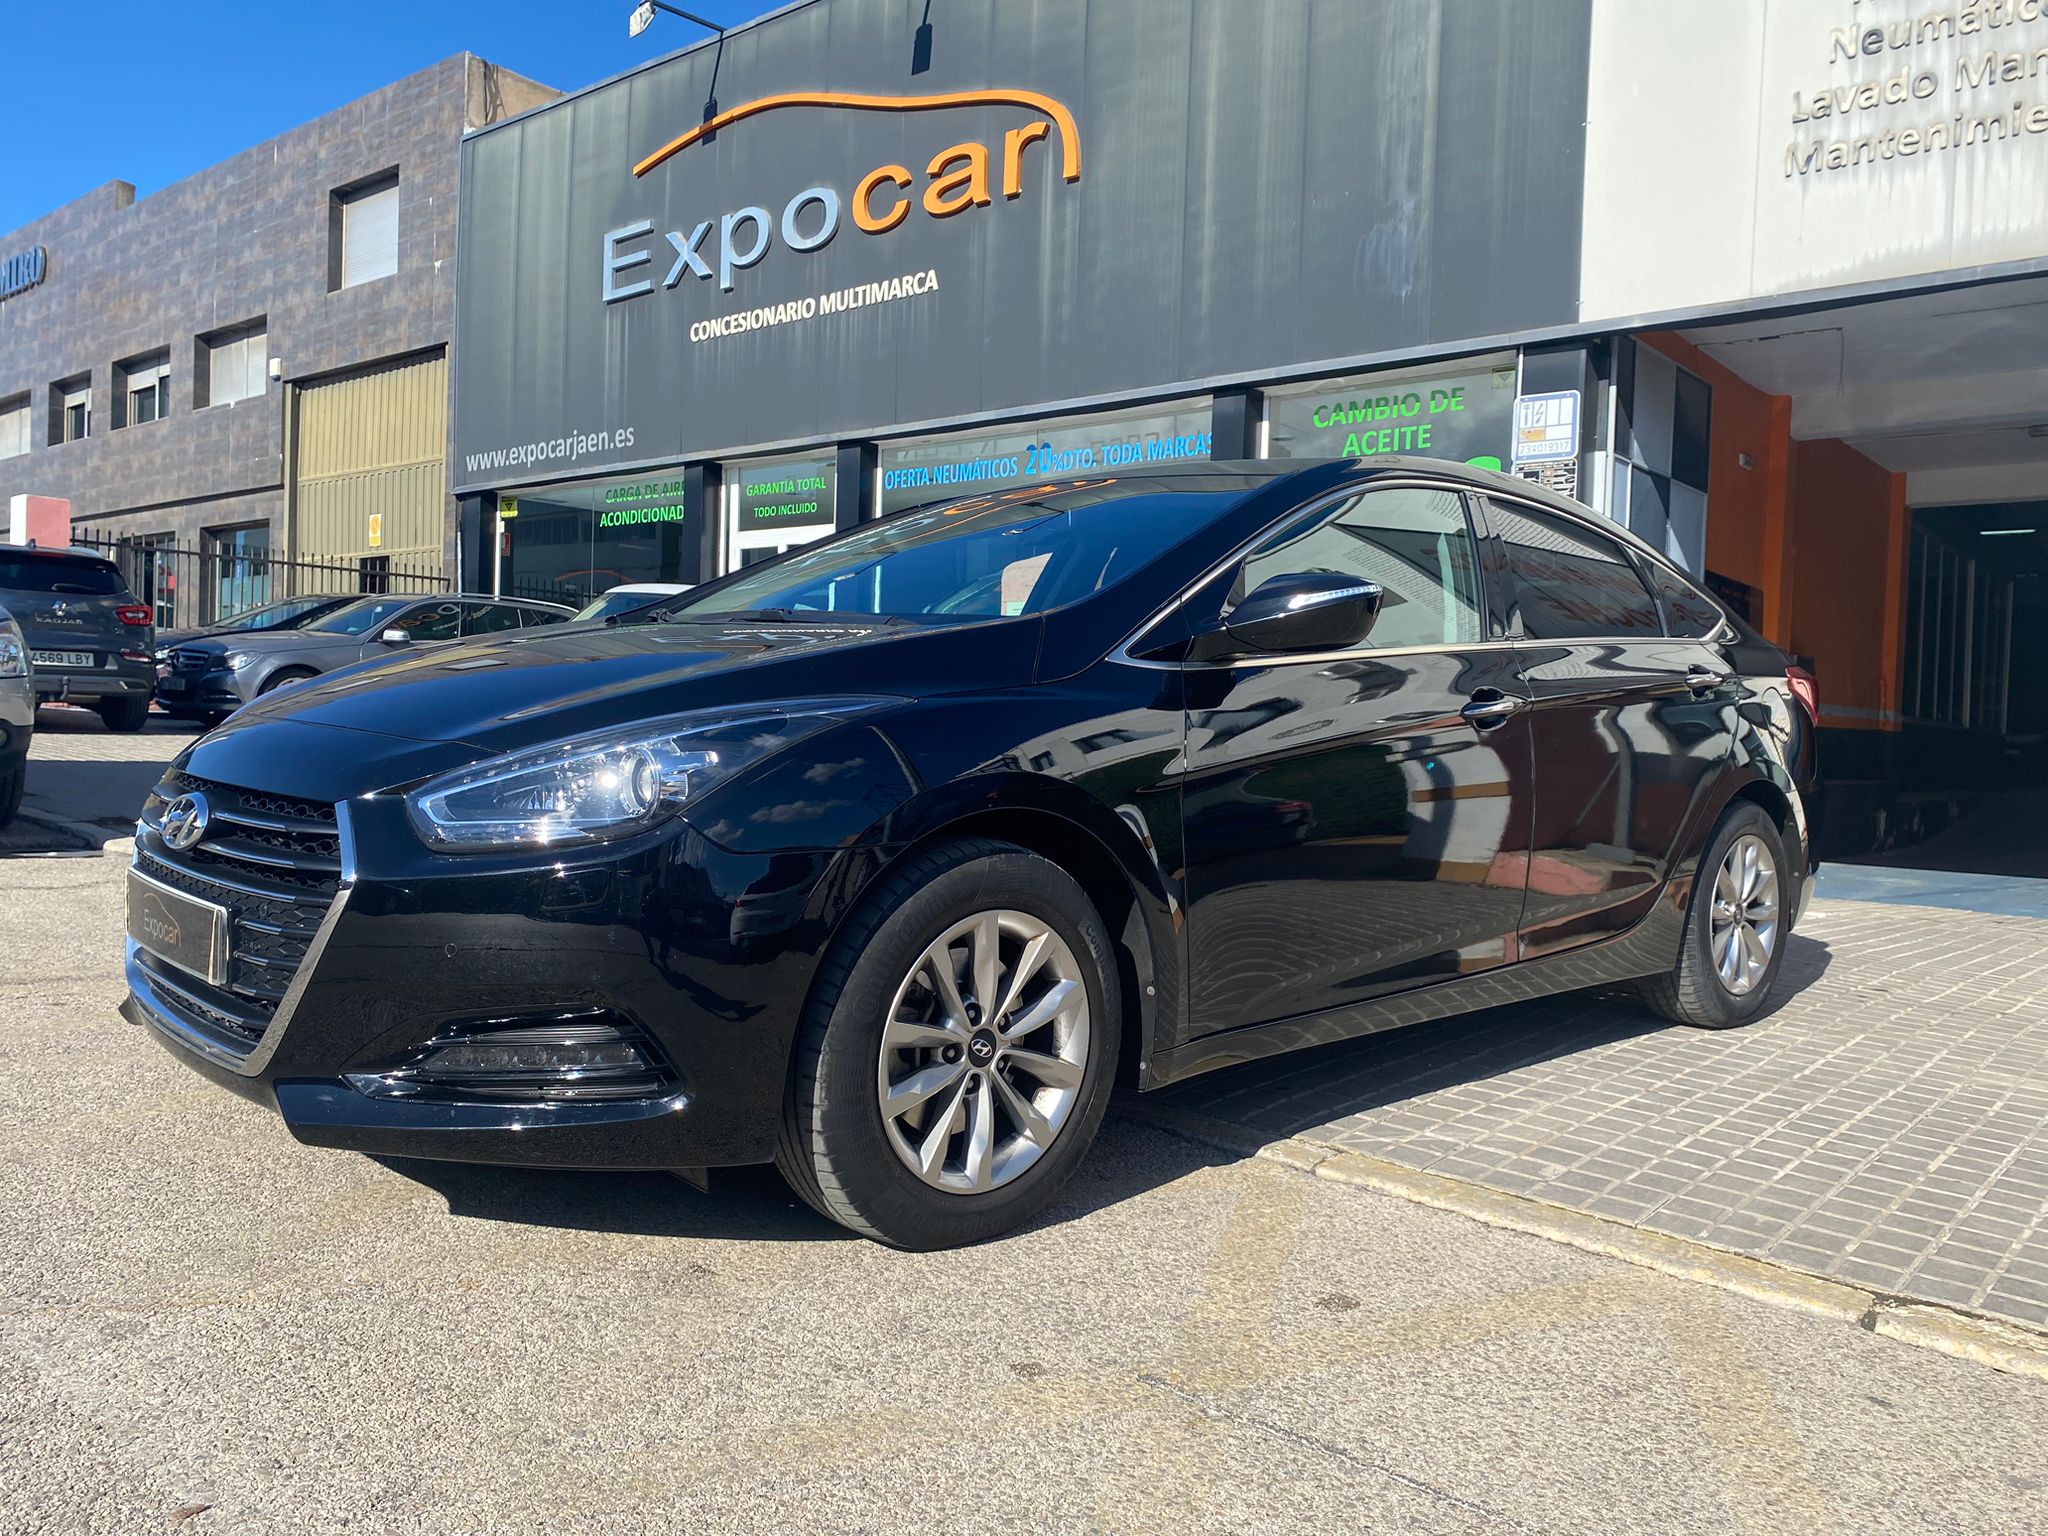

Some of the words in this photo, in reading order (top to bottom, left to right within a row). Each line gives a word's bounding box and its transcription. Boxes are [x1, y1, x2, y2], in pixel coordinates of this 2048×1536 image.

[1792, 66, 1939, 124] Lavado
[1784, 100, 2048, 178] Mantenimie
[602, 121, 1050, 306] Expocar
[689, 296, 817, 344] CONCESIONARIO
[818, 269, 939, 316] MULTIMARCA
[1312, 391, 1422, 428] CAMBIO
[1429, 386, 1466, 414] DE
[465, 425, 635, 472] www.expocarjaen.es
[1341, 423, 1433, 458] ACEITE
[797, 476, 827, 491] TOTAL
[884, 466, 931, 490] OFERTA
[932, 456, 1018, 485] NEUMÁTICOS
[1102, 441, 1143, 467] TODA
[605, 484, 642, 504] CARGA
[644, 482, 659, 499] DE
[754, 505, 777, 518] TODO
[778, 501, 818, 516] INCLUIDO
[31, 651, 64, 664] 4569
[66, 653, 91, 665] LBY
[143, 908, 178, 946] Expocar
